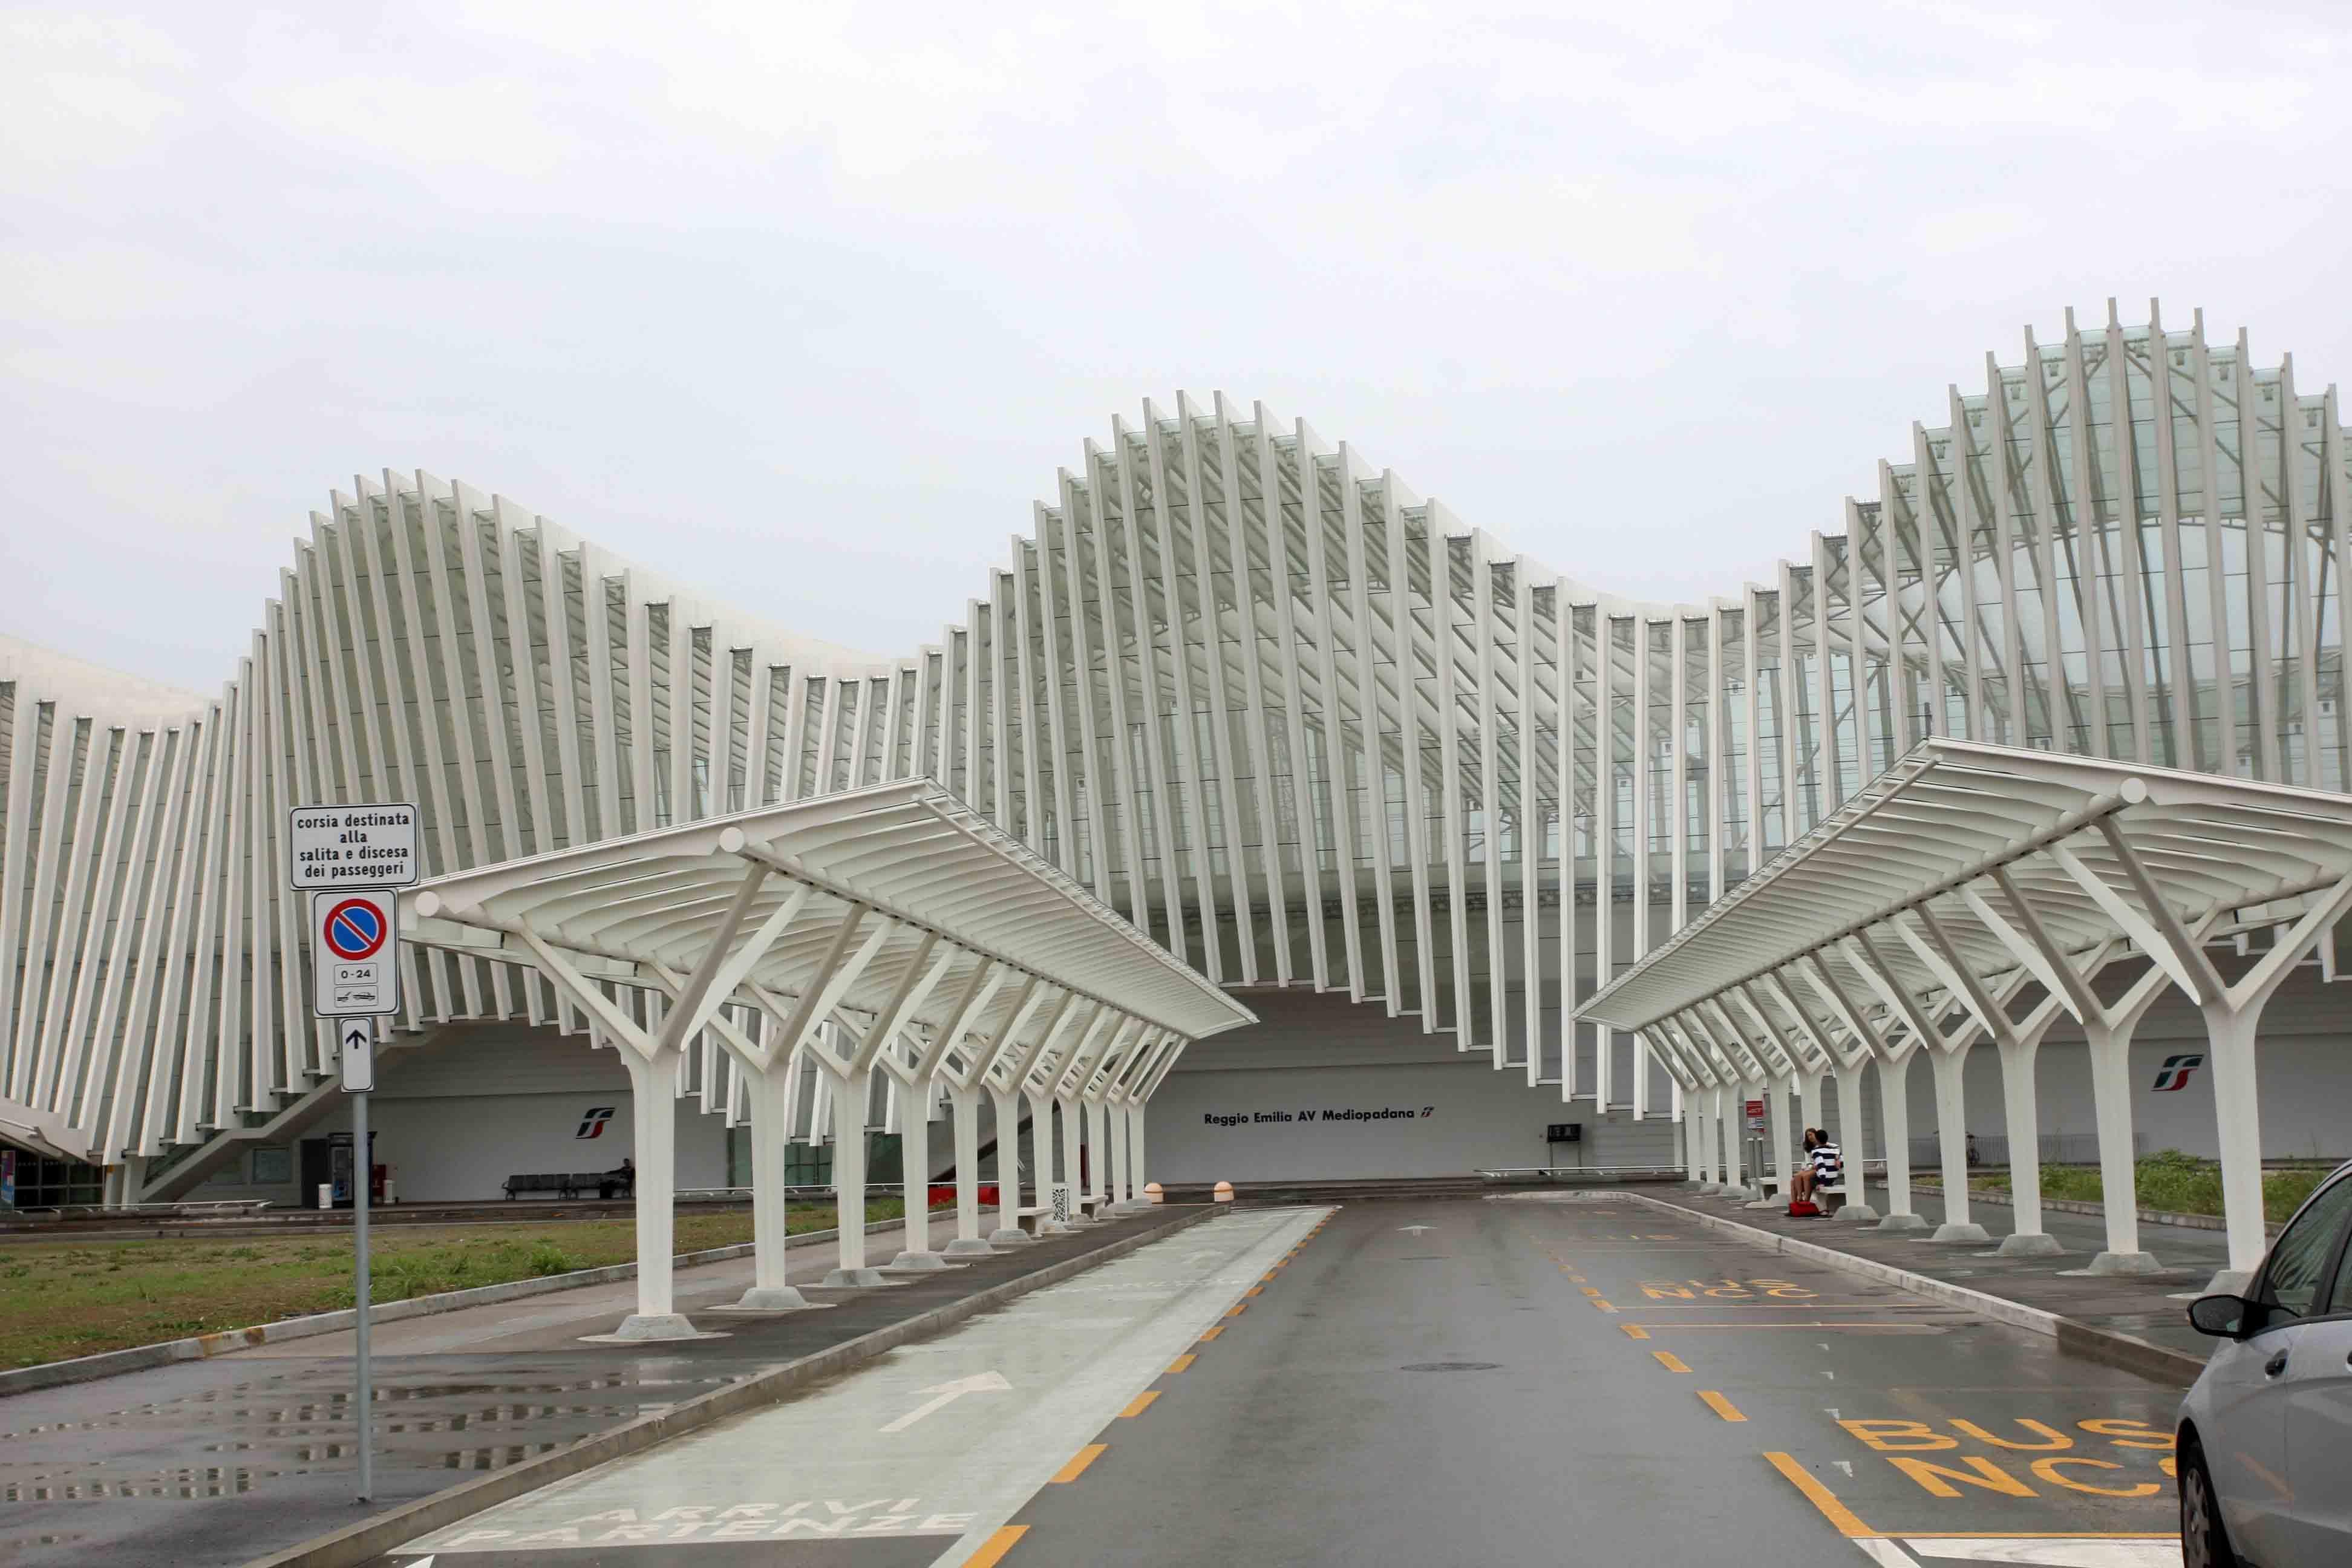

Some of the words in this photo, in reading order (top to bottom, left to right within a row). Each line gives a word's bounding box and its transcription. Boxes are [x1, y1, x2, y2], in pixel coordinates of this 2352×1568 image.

[298, 815, 339, 828] corsia
[345, 813, 410, 827] destinata
[339, 830, 368, 843] alla
[299, 848, 339, 861] salita
[346, 849, 353, 860] e
[359, 846, 408, 859] discesa
[305, 864, 325, 877] dei
[332, 861, 404, 879] passeggeri
[1204, 1113, 1249, 1126] Reggio
[1253, 1111, 1293, 1123] Emilia
[1297, 1110, 1316, 1122] AV
[1322, 1108, 1415, 1122] Mediopadana
[1640, 1287, 1819, 1299] NCC
[1835, 1419, 2176, 1450] BUS
[1885, 1455, 2177, 1497] NC
[563, 1498, 920, 1525] ARRIVI
[442, 1513, 978, 1547] PARTENZE
